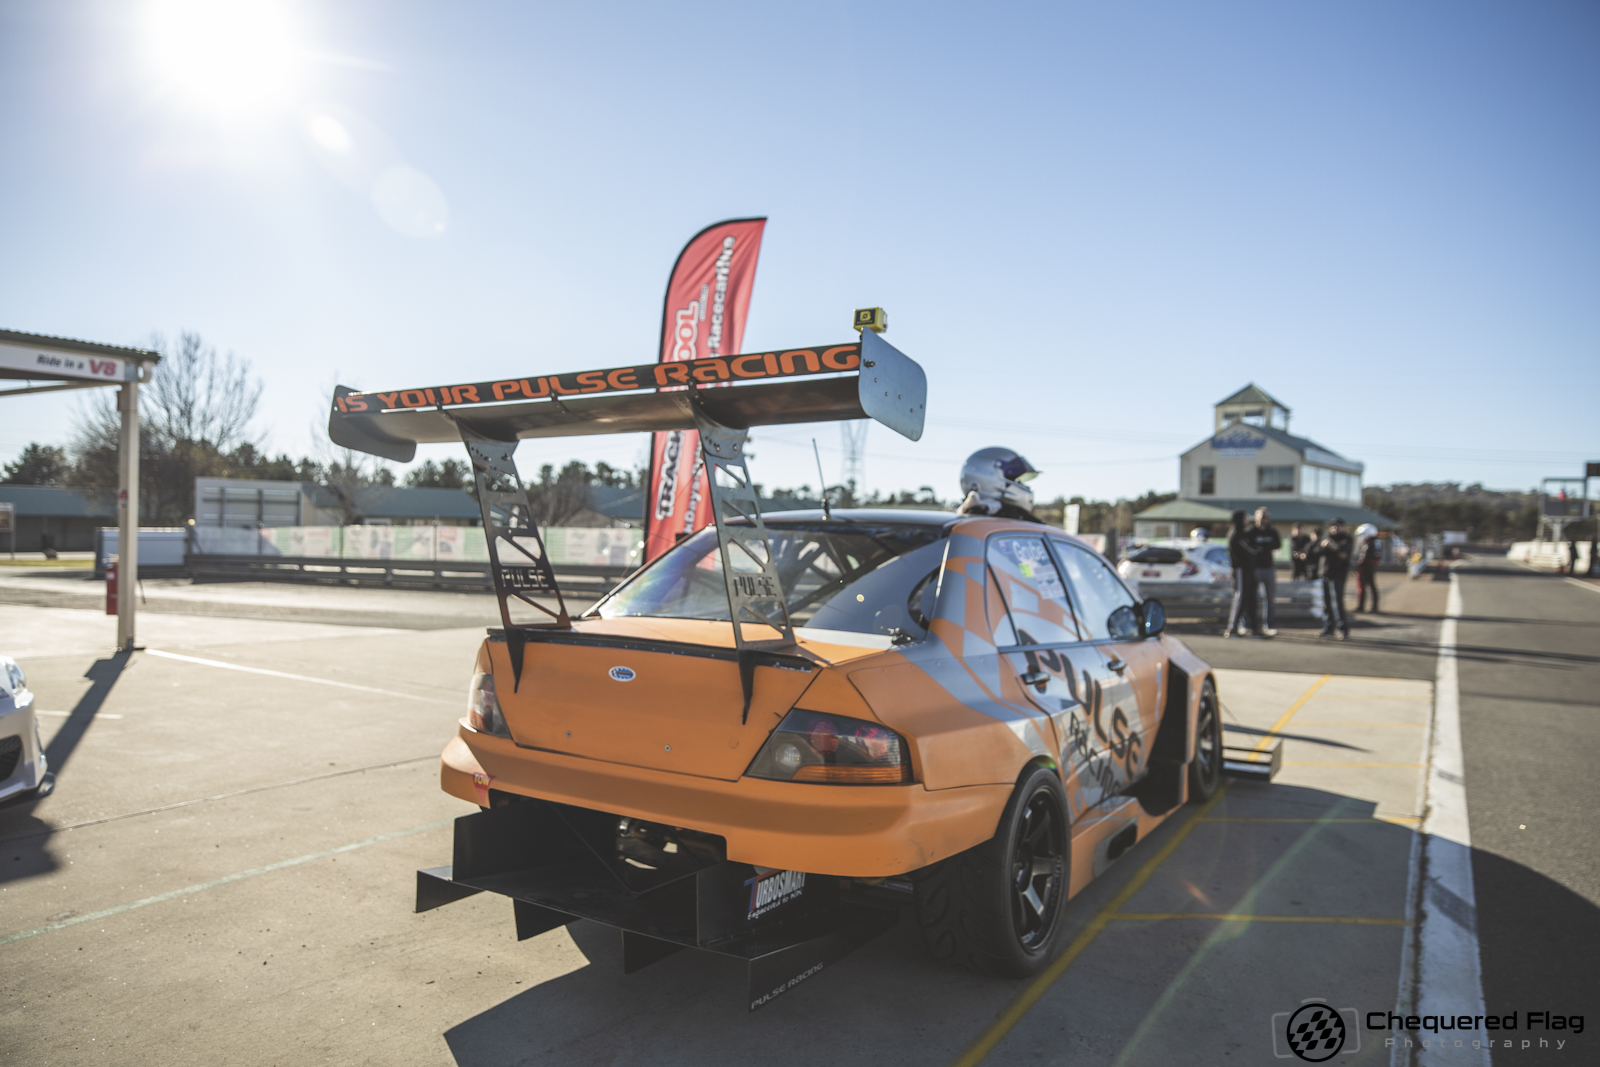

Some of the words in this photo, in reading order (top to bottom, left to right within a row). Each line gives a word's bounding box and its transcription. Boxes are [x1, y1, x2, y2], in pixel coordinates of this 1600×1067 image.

[37, 354, 62, 367] Ride
[64, 357, 74, 368] in
[77, 361, 84, 369] a
[89, 359, 117, 376] V8
[337, 395, 368, 413] IS
[377, 384, 480, 409] YOUR
[492, 368, 639, 400] PULSE
[501, 569, 549, 588] PULSE
[733, 575, 778, 597] PULSE
[1018, 629, 1142, 783] PULSE
[474, 774, 490, 786] TOW
[744, 869, 806, 911] TURBOSMART
[751, 984, 786, 1009] PULSE
